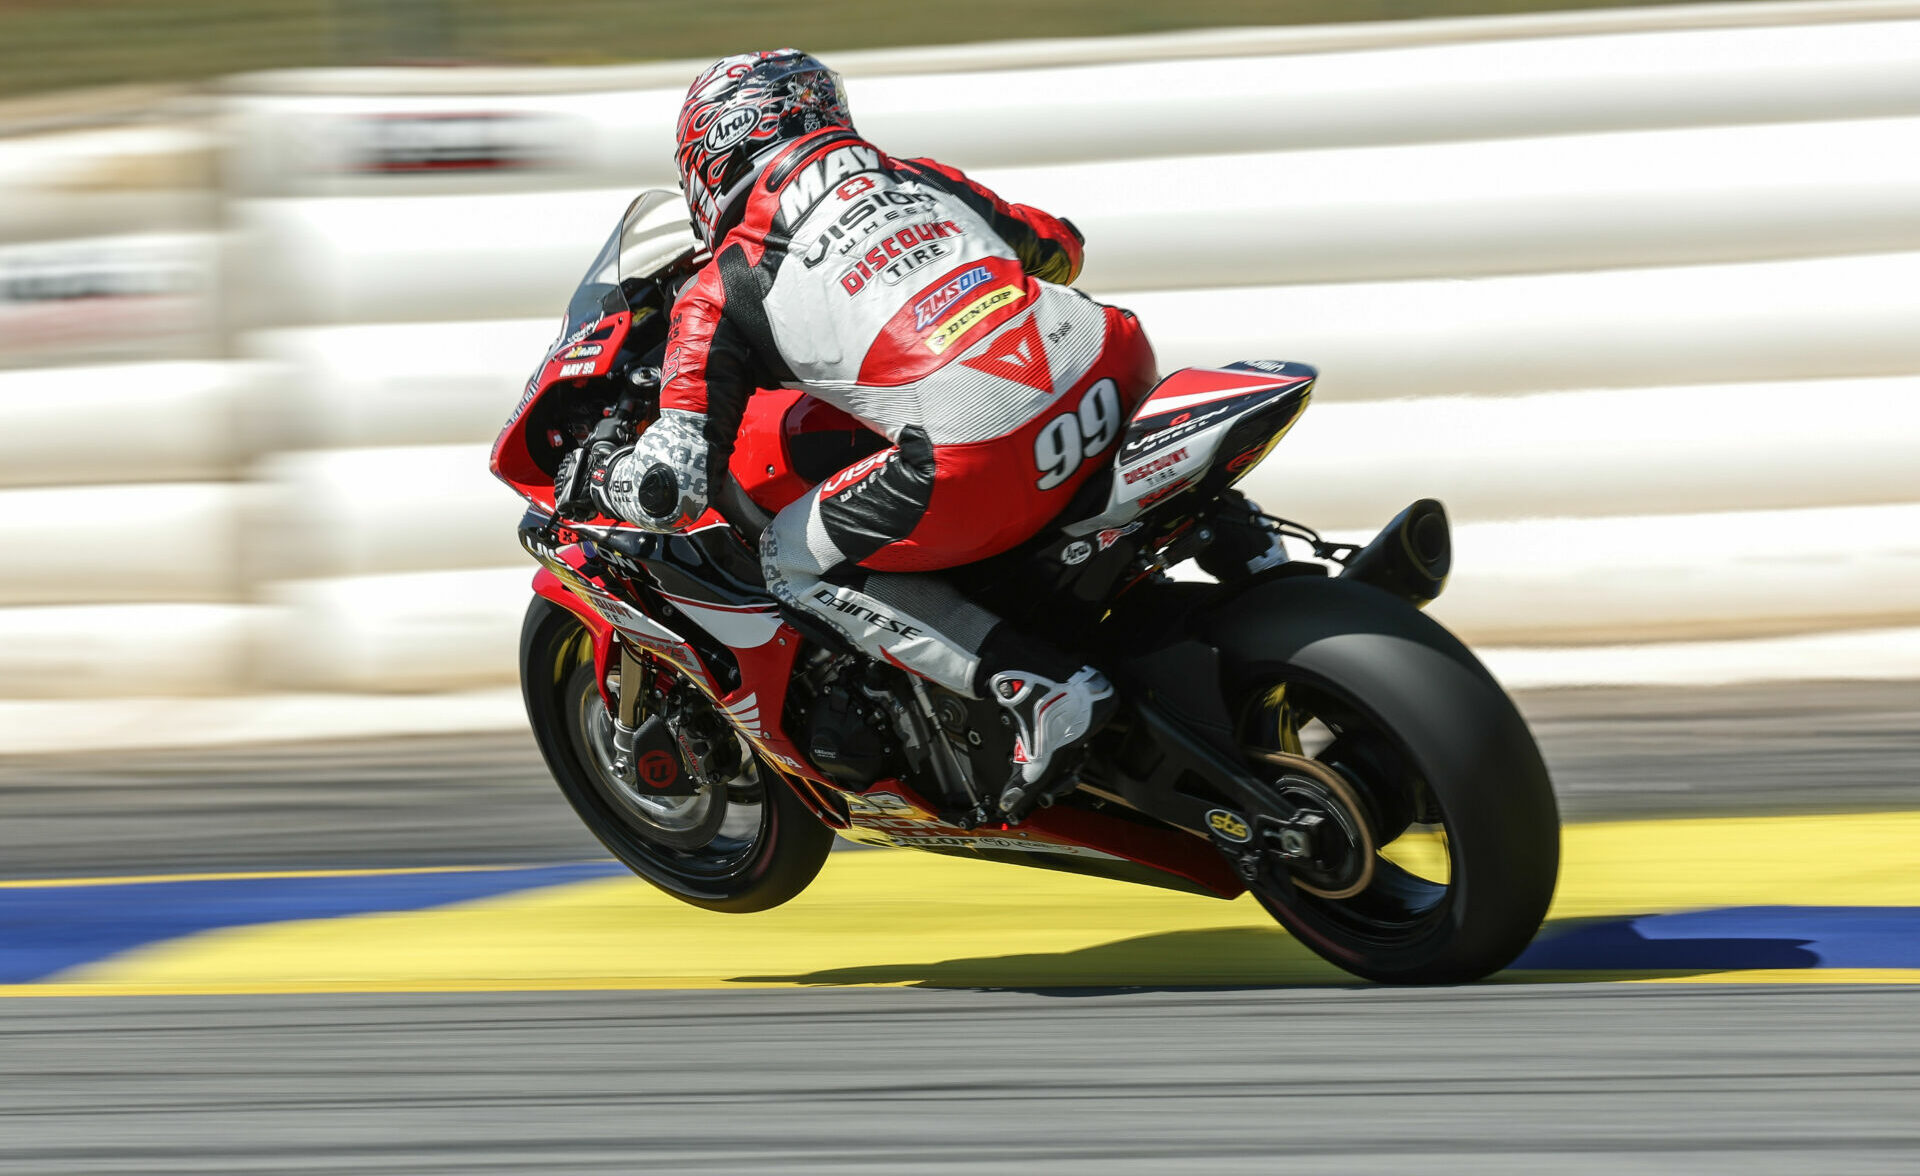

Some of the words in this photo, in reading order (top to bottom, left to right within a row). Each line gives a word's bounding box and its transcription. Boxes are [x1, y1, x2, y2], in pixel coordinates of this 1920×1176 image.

[710, 108, 752, 148] Arai
[779, 146, 880, 230] MAY
[886, 244, 944, 278] TIRE
[914, 266, 994, 332] AMSOIL
[947, 290, 1012, 334] DUNLOP
[560, 363, 584, 378] MAY
[582, 361, 596, 375] 99
[1034, 377, 1120, 491] 99
[1123, 446, 1190, 486] DISCOUNT
[813, 589, 922, 640] DAINESE
[1210, 812, 1247, 838] sbs
